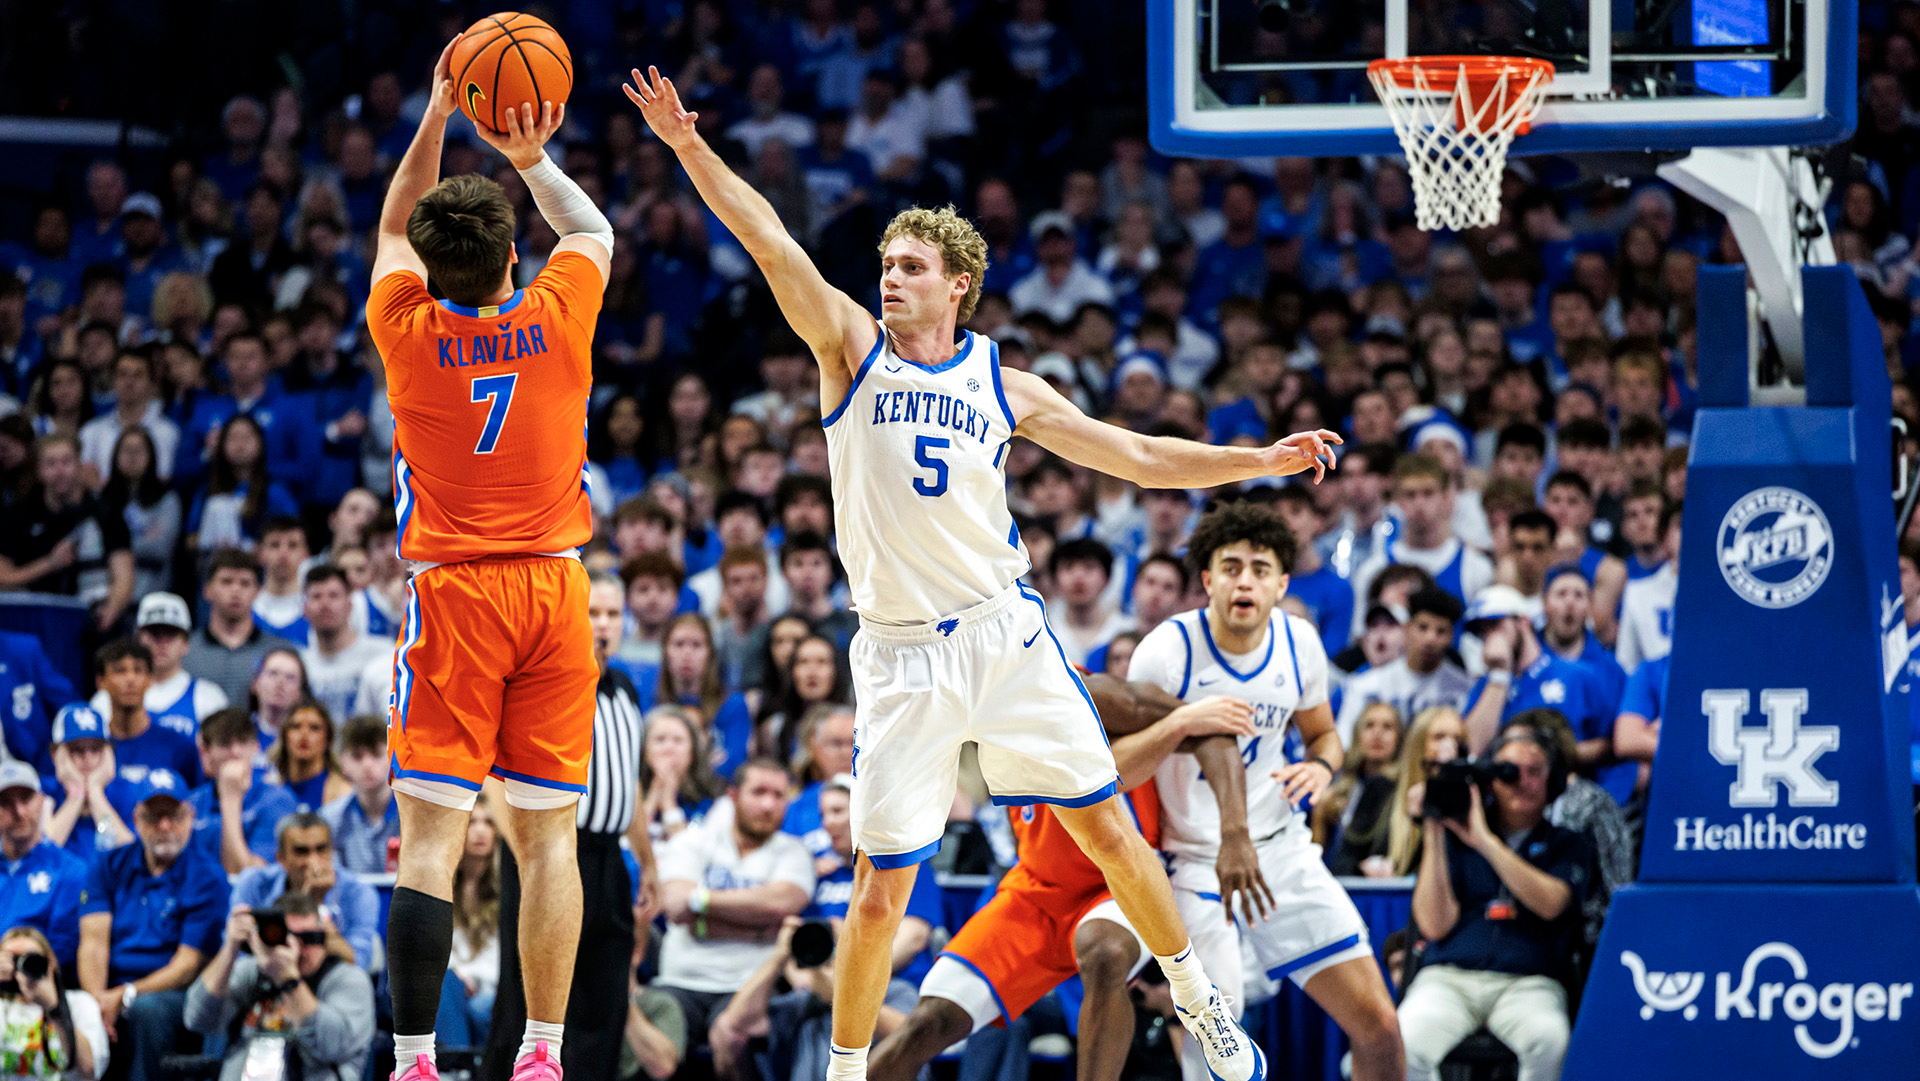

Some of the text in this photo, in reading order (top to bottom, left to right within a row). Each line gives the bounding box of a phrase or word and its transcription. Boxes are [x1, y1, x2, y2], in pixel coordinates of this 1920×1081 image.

[438, 321, 548, 367] KLAVŽAR
[471, 372, 519, 454] 7
[872, 391, 989, 444] KENTUCKY
[912, 435, 950, 497] 5
[1702, 688, 1839, 808] UK
[1674, 813, 1867, 850] HealthCare
[1715, 941, 1914, 1058] Kroger
